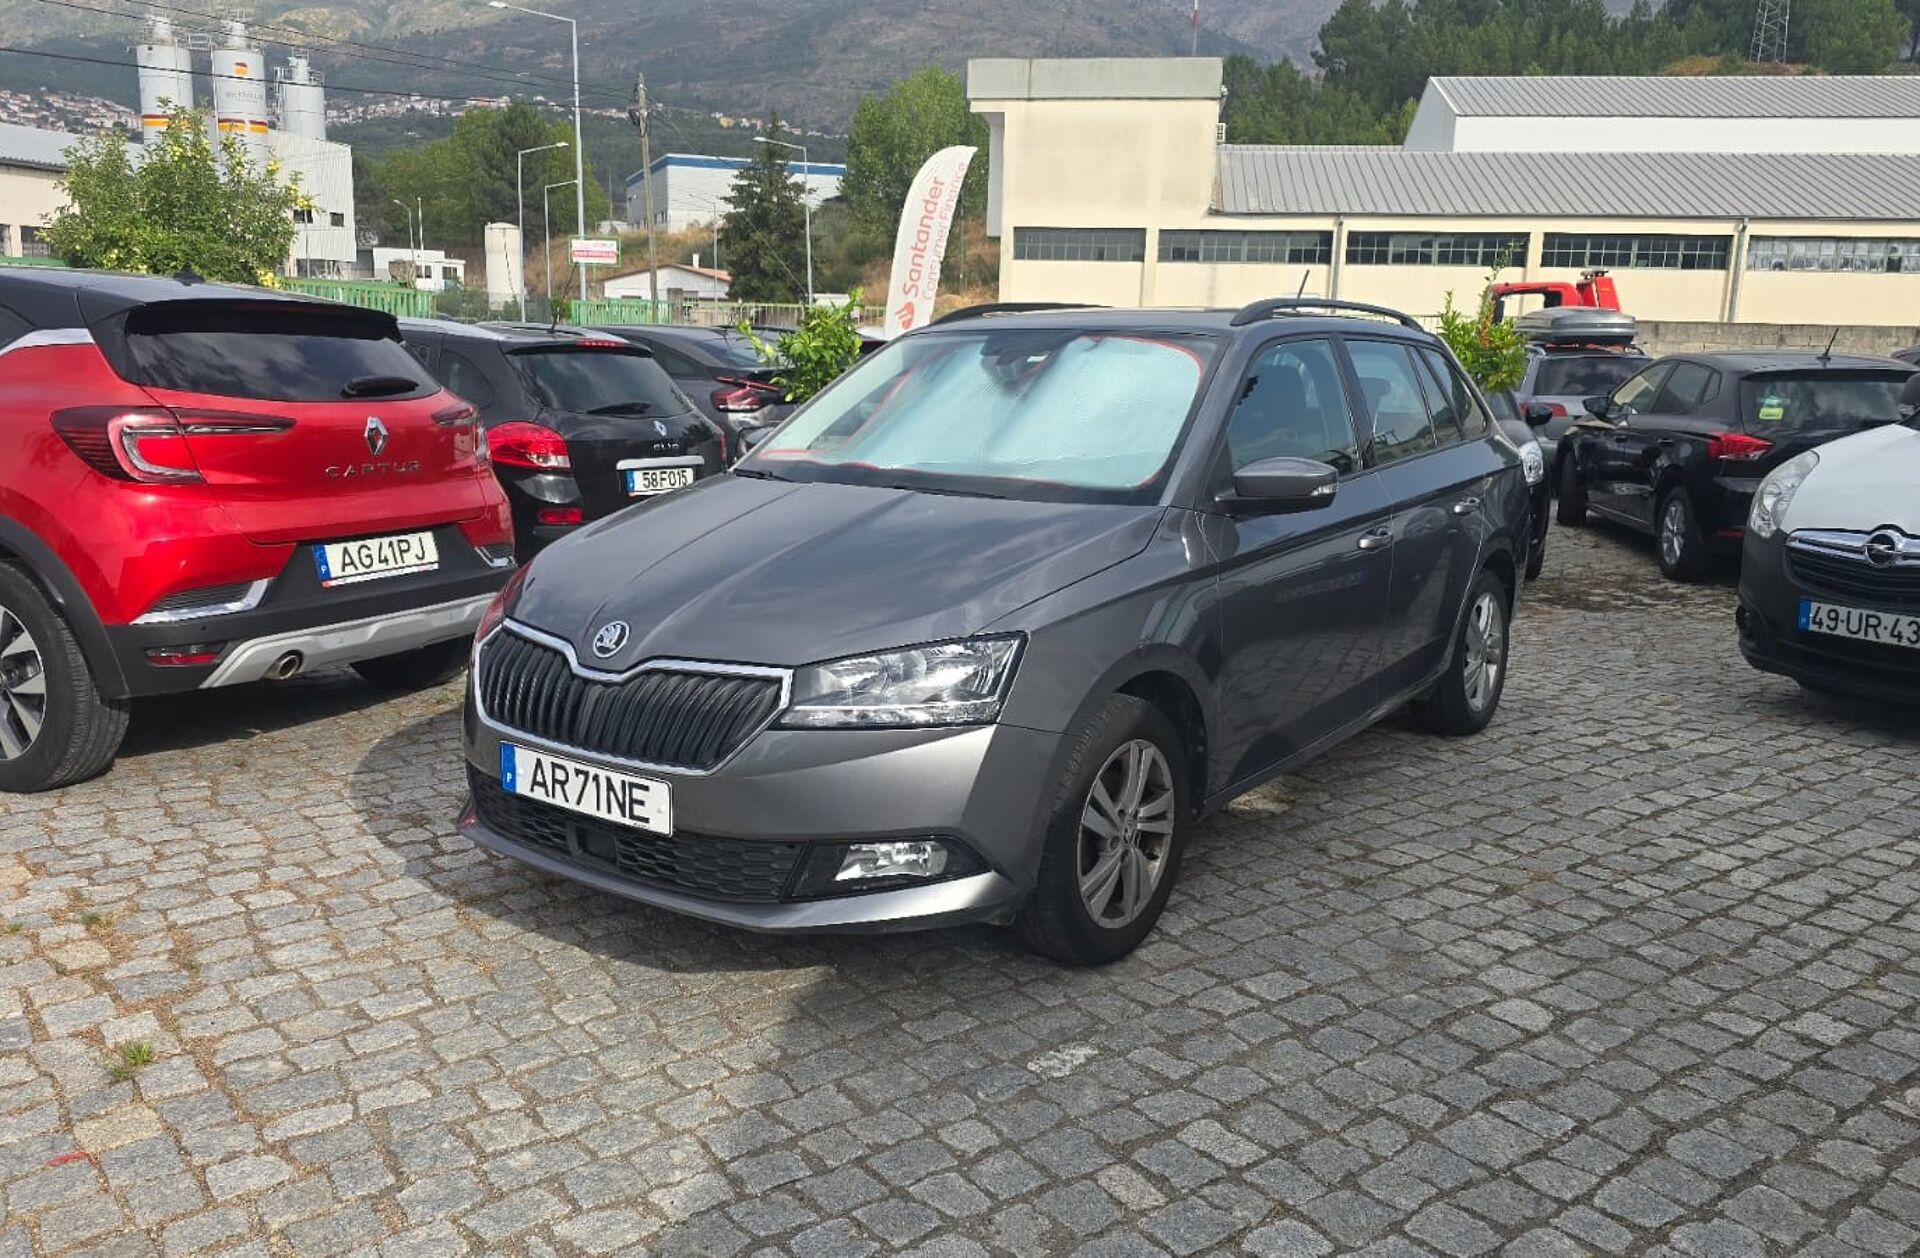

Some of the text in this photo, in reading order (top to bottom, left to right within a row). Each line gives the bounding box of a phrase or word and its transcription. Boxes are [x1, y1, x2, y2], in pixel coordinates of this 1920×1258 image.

[903, 176, 945, 297] Santander
[922, 162, 965, 300] Consumer Finance
[325, 461, 420, 477] CAPTUR
[341, 536, 426, 573] AG41PJ
[530, 757, 650, 824] AR71NE
